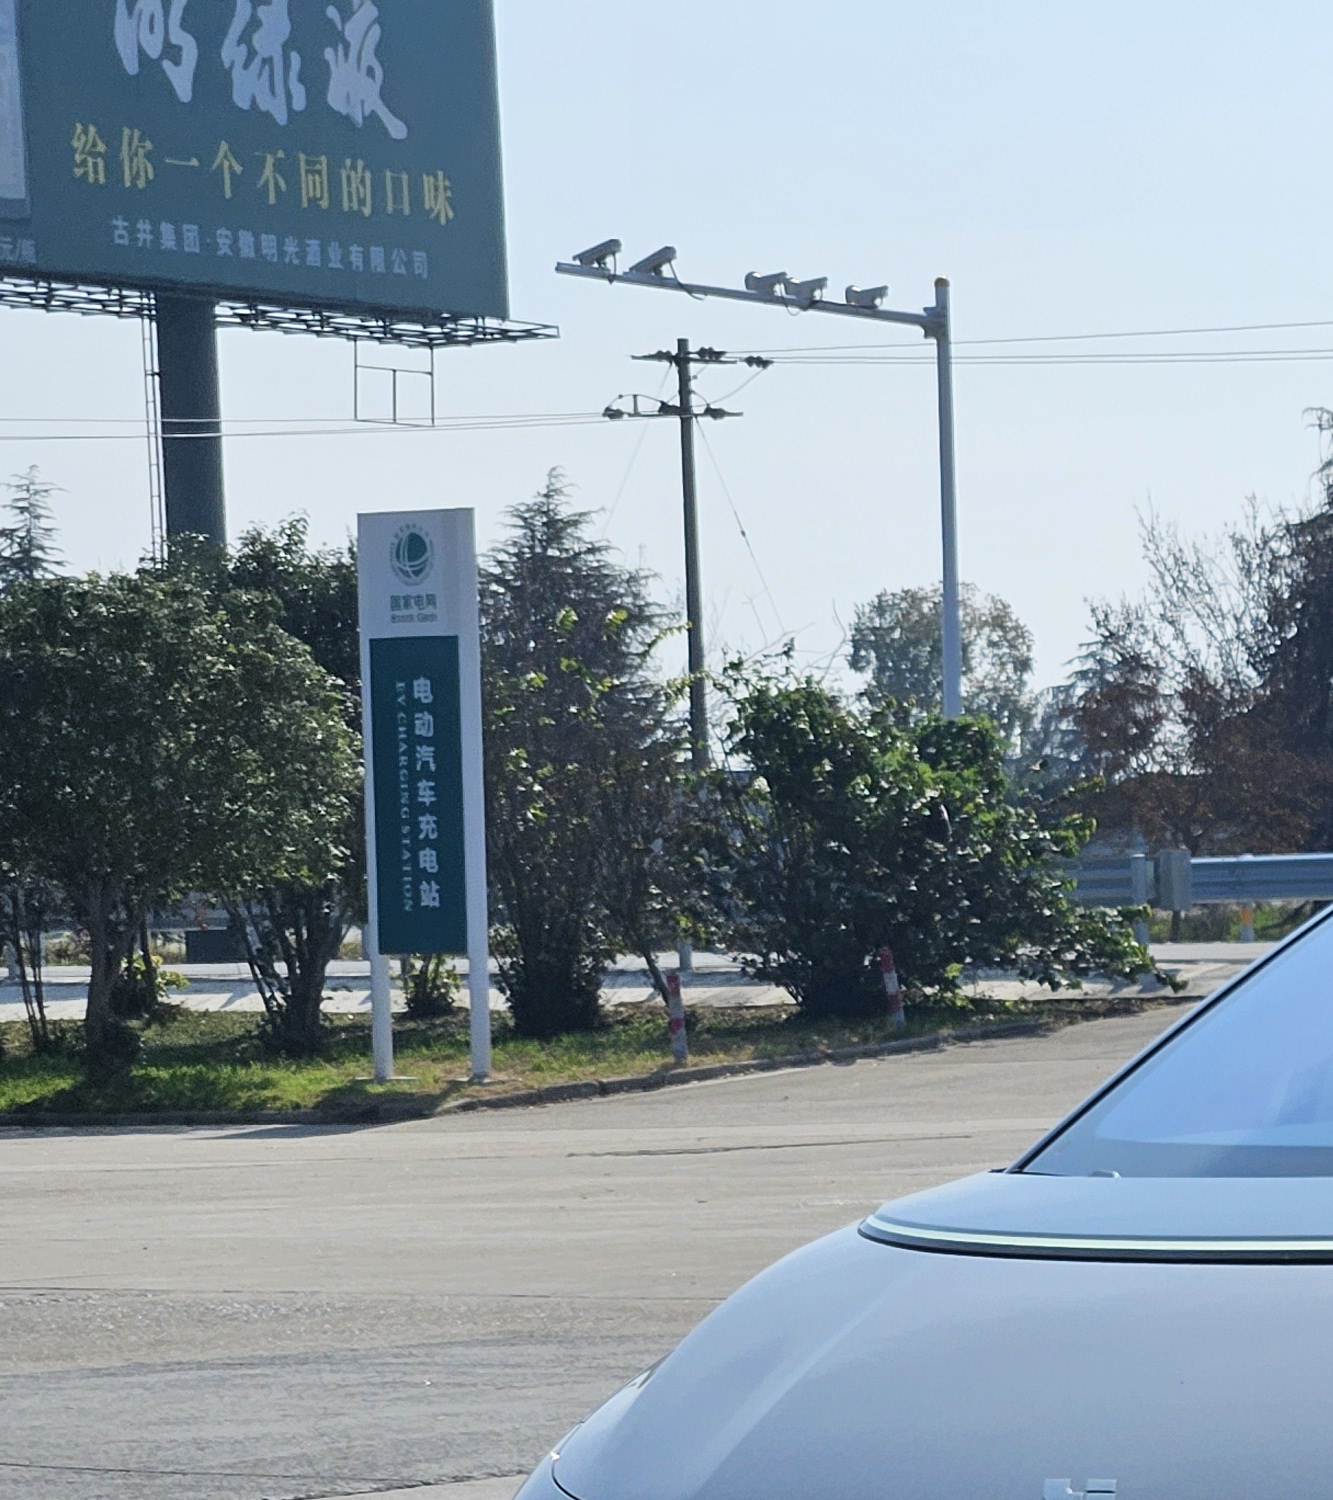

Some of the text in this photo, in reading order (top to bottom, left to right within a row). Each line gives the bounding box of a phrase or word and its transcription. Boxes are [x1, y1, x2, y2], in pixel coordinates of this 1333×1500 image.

[71, 122, 454, 226] 给你一个不同的口味
[397, 711, 409, 819] CHARGING
[413, 676, 440, 908] 电动汽车充电站
[401, 825, 413, 911] STATION
